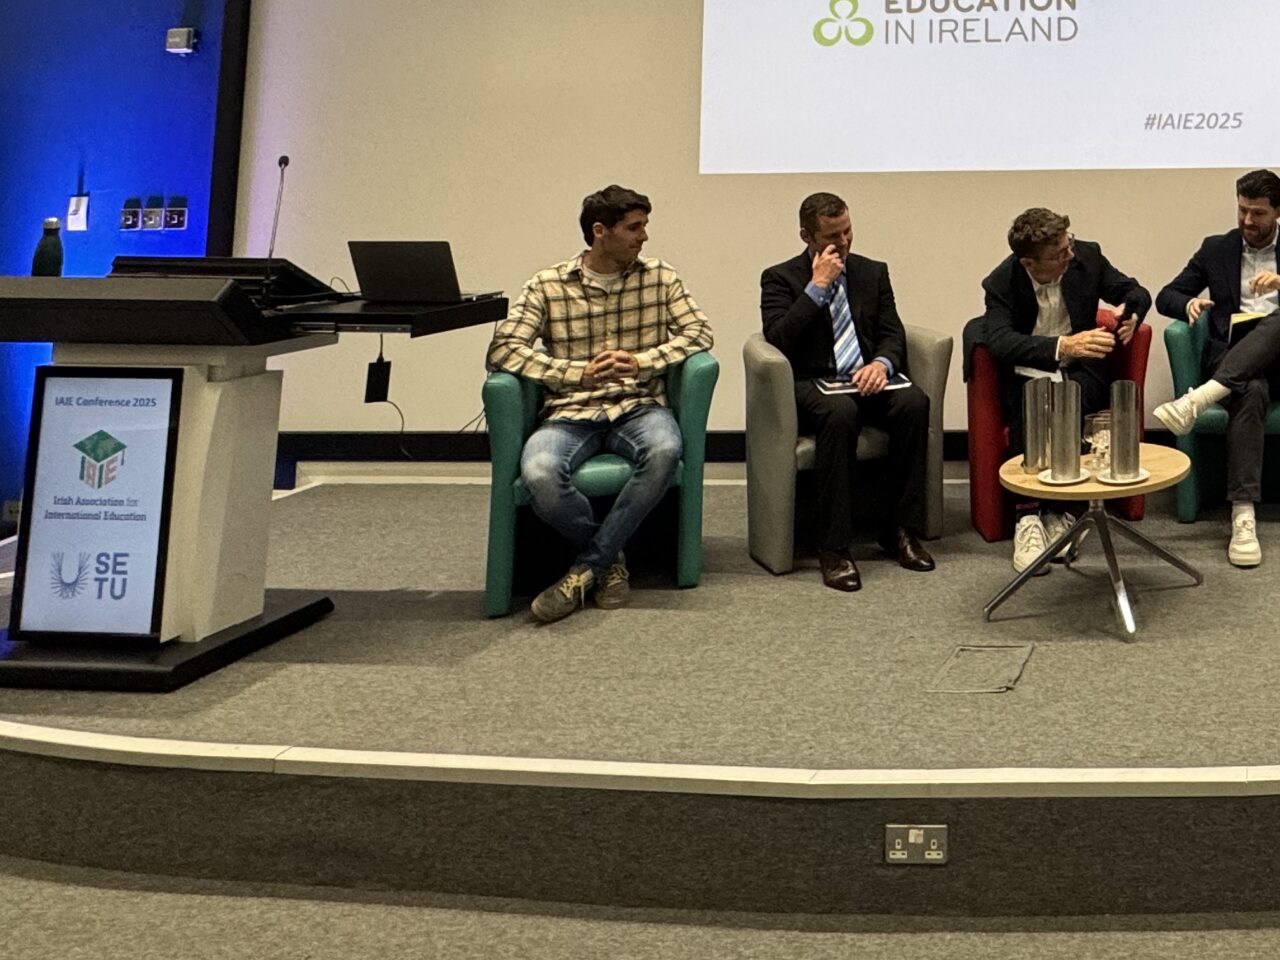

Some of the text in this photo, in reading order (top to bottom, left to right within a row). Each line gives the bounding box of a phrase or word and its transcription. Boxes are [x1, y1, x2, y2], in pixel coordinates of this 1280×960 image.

[885, 16, 1079, 44] IN IRELAND
[1144, 112, 1244, 130] #IAIE2025
[76, 397, 131, 407] Conference
[132, 398, 157, 407] 2025
[76, 497, 124, 506] Association
